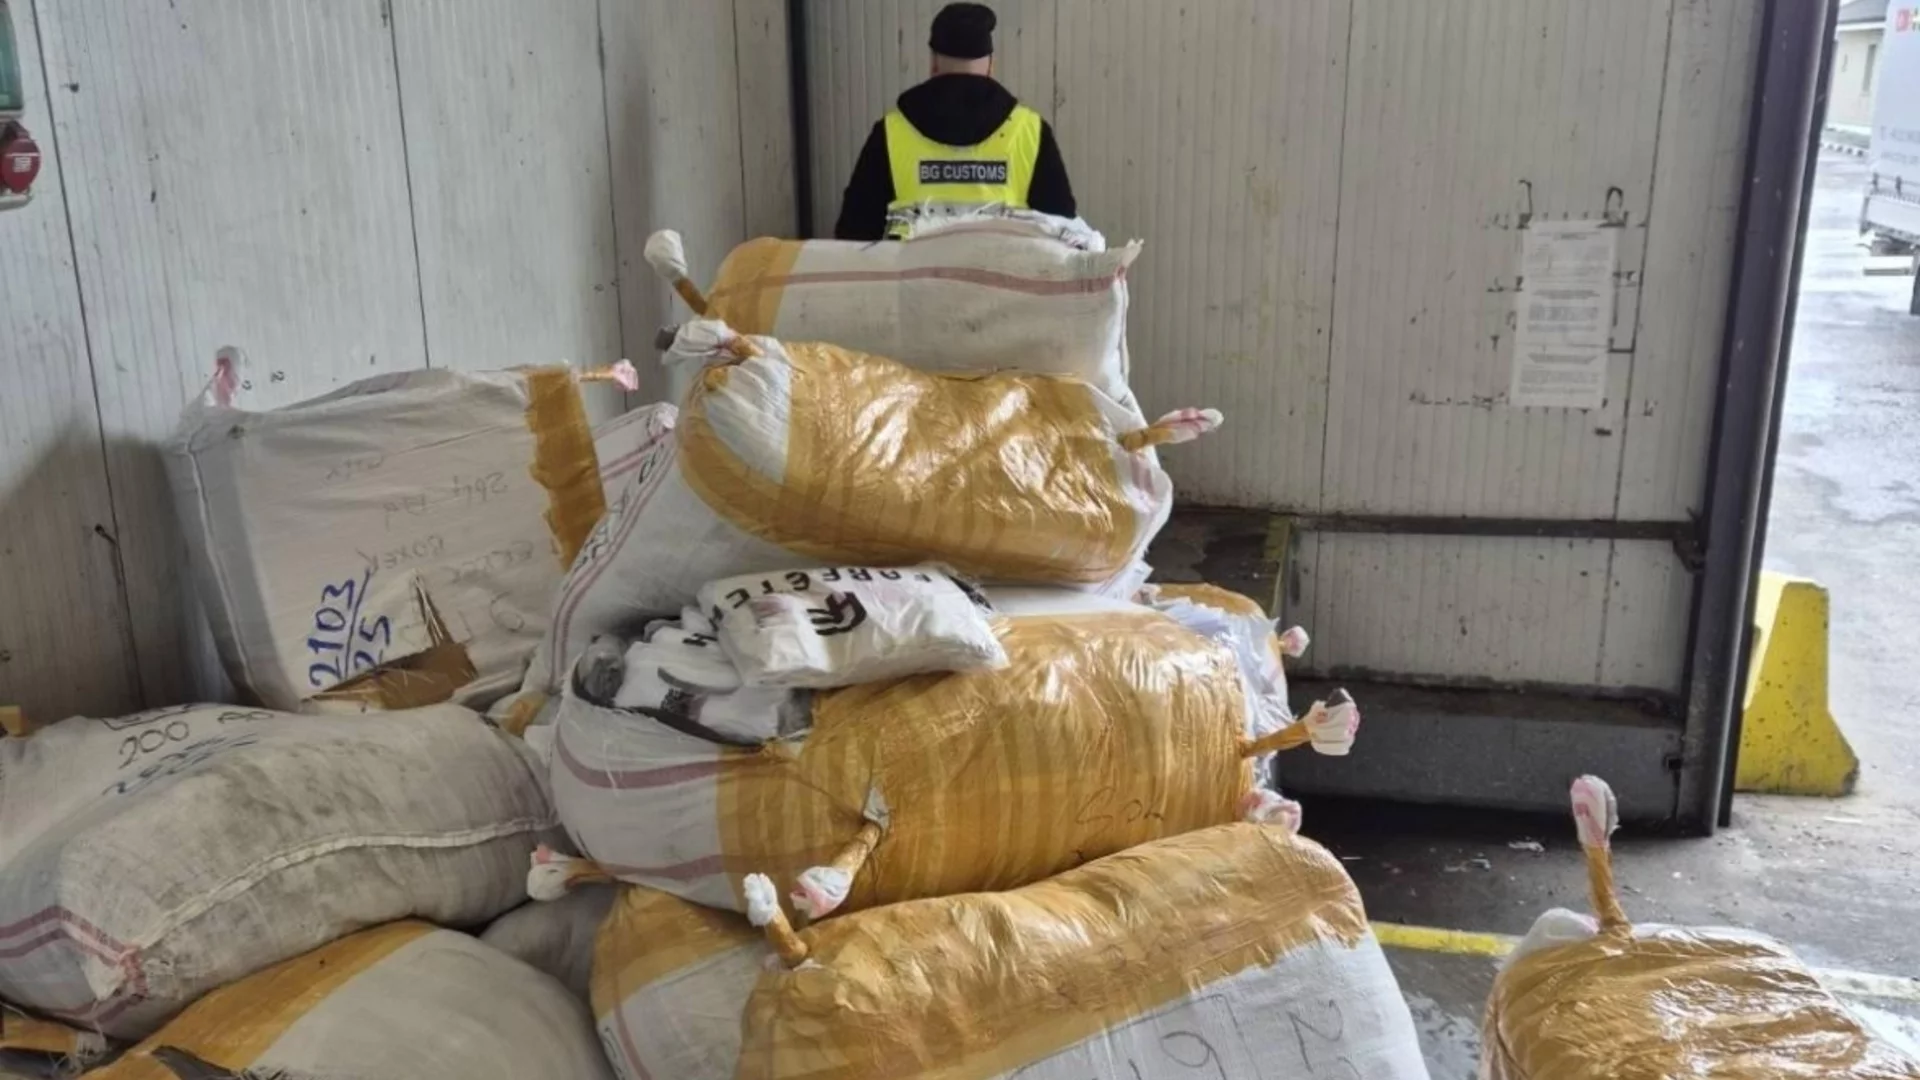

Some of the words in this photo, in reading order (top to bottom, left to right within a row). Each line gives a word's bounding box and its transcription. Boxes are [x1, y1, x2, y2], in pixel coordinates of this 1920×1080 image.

[920, 164, 940, 180] BG
[942, 163, 1007, 181] CUSTOMS
[308, 578, 357, 688] 2103
[355, 614, 392, 670] 25
[117, 720, 190, 771] 200
